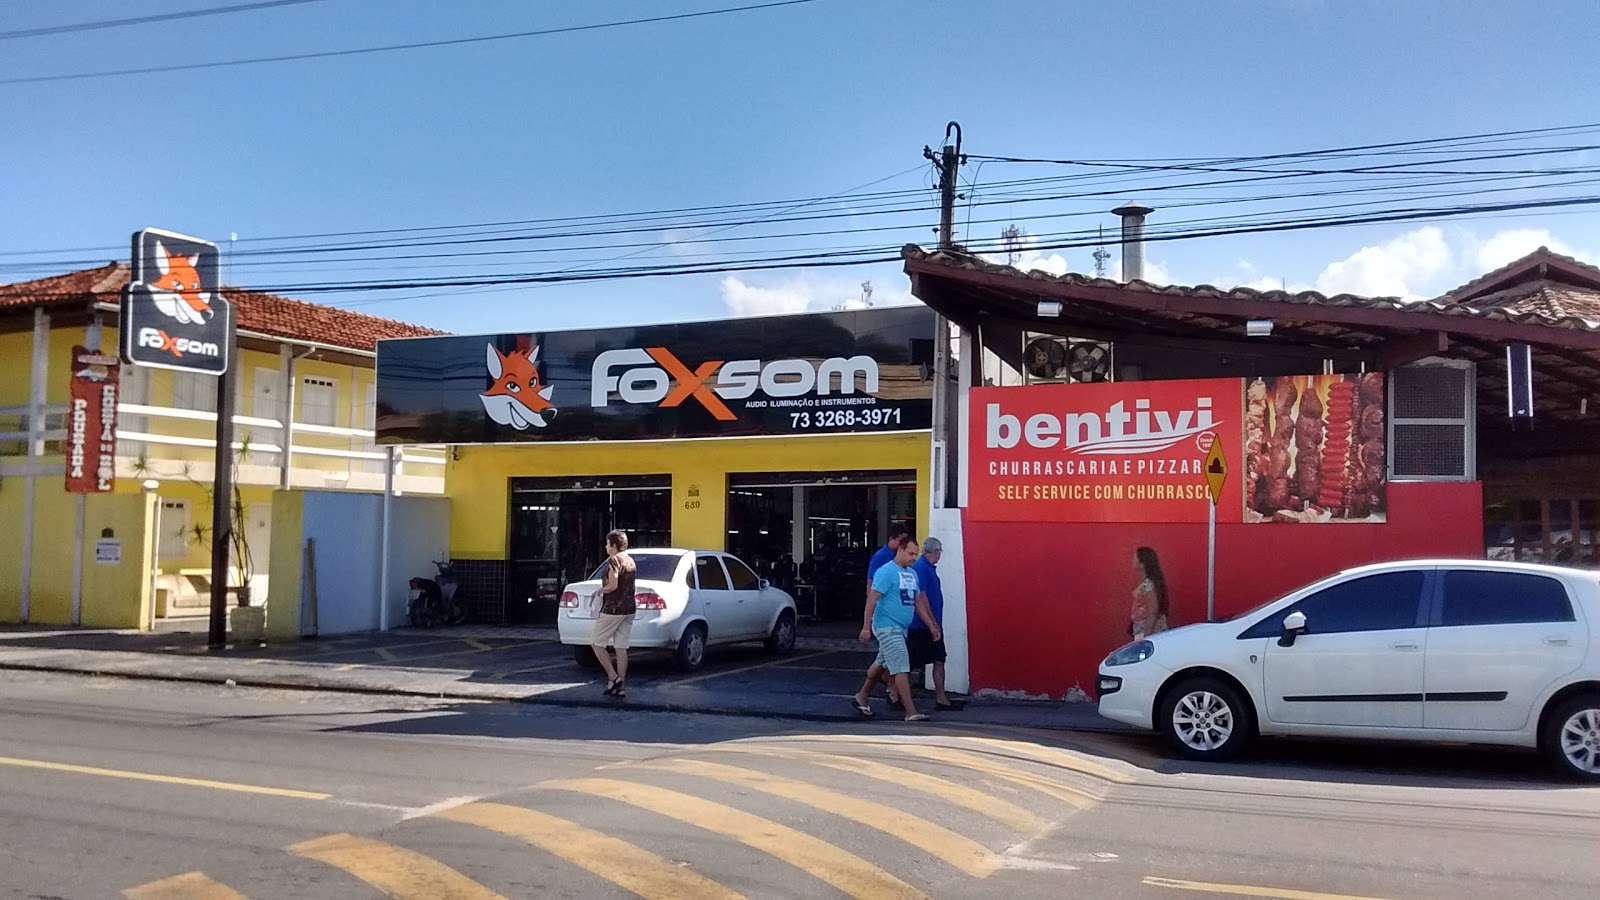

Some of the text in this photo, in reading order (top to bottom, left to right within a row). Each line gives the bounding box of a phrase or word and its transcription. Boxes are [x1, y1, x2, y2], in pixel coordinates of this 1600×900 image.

[770, 398, 813, 408] ILUMINAÇÃO
[821, 398, 876, 406] INSTRUMENTOS
[790, 408, 901, 429] 73 3268-3971
[986, 397, 1213, 449] bentivi
[71, 399, 87, 478] POUSADA
[989, 459, 1201, 476] CHURRASCARIA E PIZZAR
[998, 485, 1030, 500] SELF
[1034, 485, 1091, 500] SERVICE
[1094, 485, 1124, 500] COM
[685, 500, 701, 510] 680
